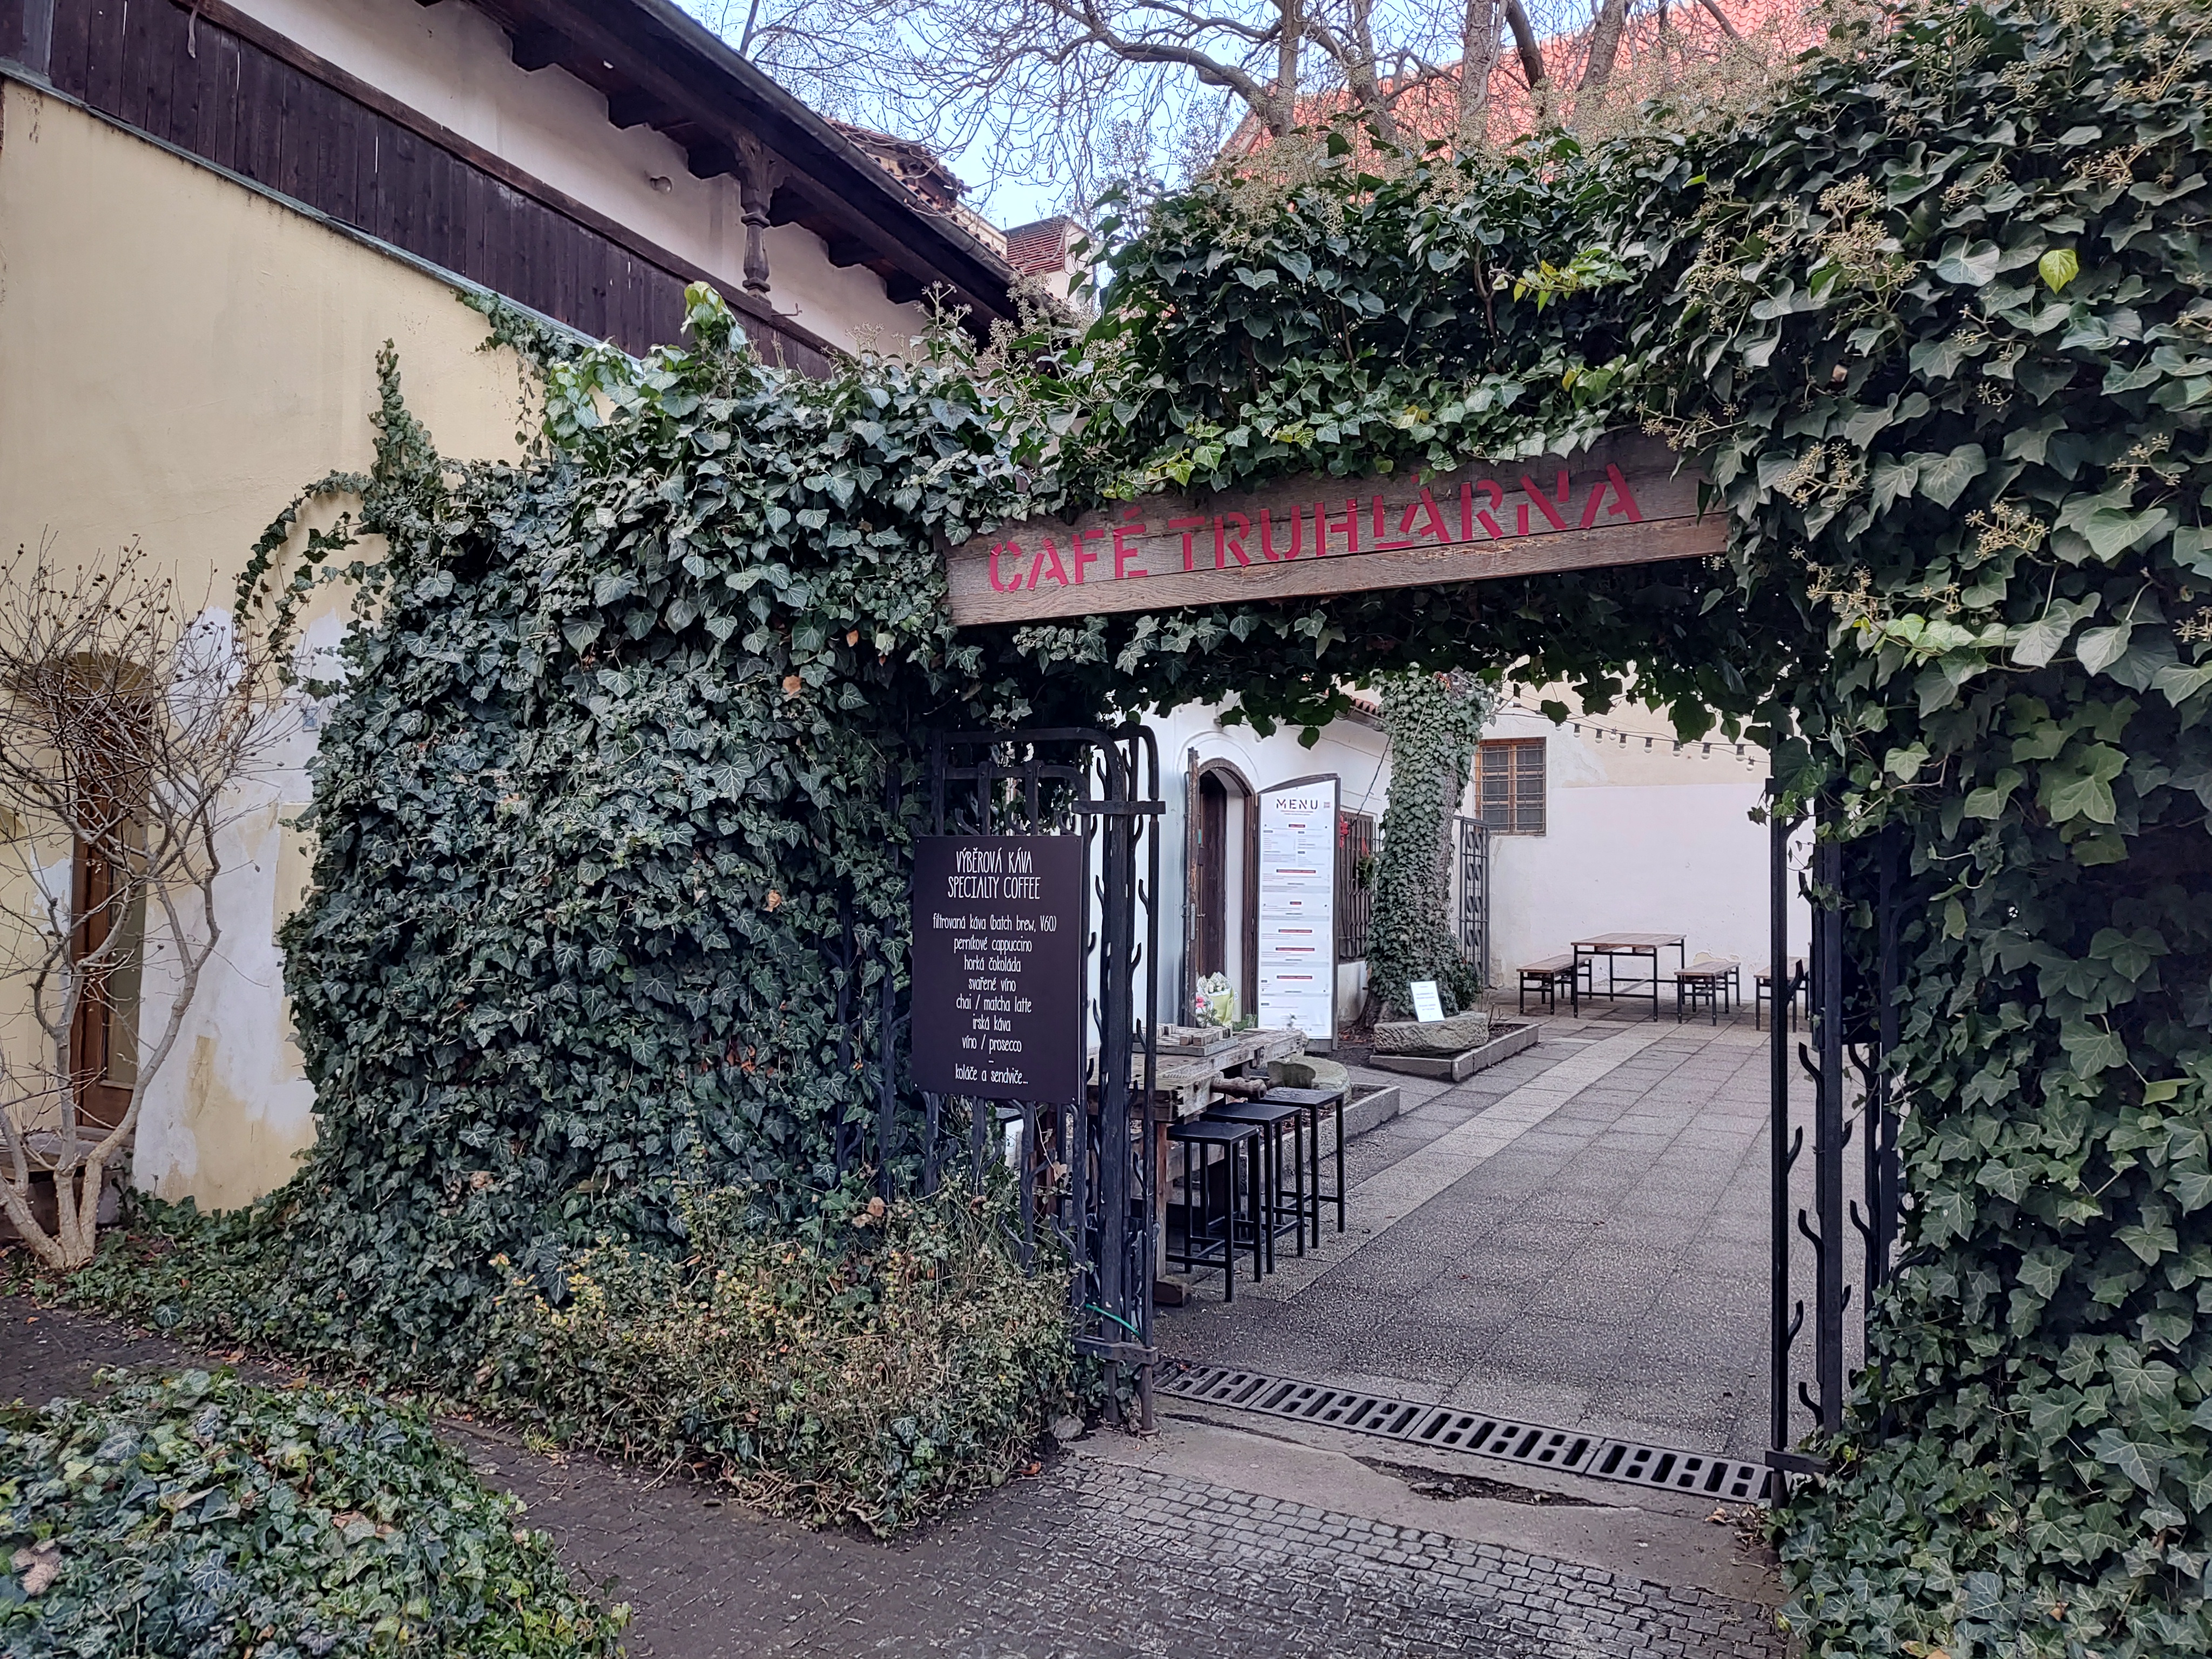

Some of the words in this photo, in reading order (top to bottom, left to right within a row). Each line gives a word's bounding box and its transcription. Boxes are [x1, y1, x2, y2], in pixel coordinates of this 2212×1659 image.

[989, 507, 1148, 593] CAFÉ
[1168, 465, 1643, 572] TRUHLÁRNA
[1276, 799, 1318, 810] MENU
[956, 847, 1002, 874] VÝBĚROVÁ
[1008, 847, 1033, 874] KÁVA
[948, 876, 999, 899] SPECIALTY
[1003, 876, 1041, 900] COFFEE
[933, 913, 966, 930] filtrovaná
[970, 913, 986, 930] káva
[990, 914, 1012, 932] (batch
[1016, 915, 1036, 933] brew,
[1040, 915, 1057, 932] V60)
[954, 934, 988, 954] perníkové
[992, 936, 1032, 955] cappuccino
[964, 954, 984, 971] horká
[988, 956, 1021, 972] čokoláda
[968, 976, 997, 991] svařené
[1000, 977, 1016, 992] víno
[956, 993, 972, 1010] chai
[983, 995, 1010, 1012] matcha
[1014, 996, 1032, 1013] latte
[973, 1014, 990, 1030] irská
[994, 1015, 1011, 1032] káva
[962, 1035, 977, 1049] víno
[989, 1038, 1022, 1055] prosecco
[955, 1063, 977, 1081] koláče
[981, 1070, 987, 1082] a
